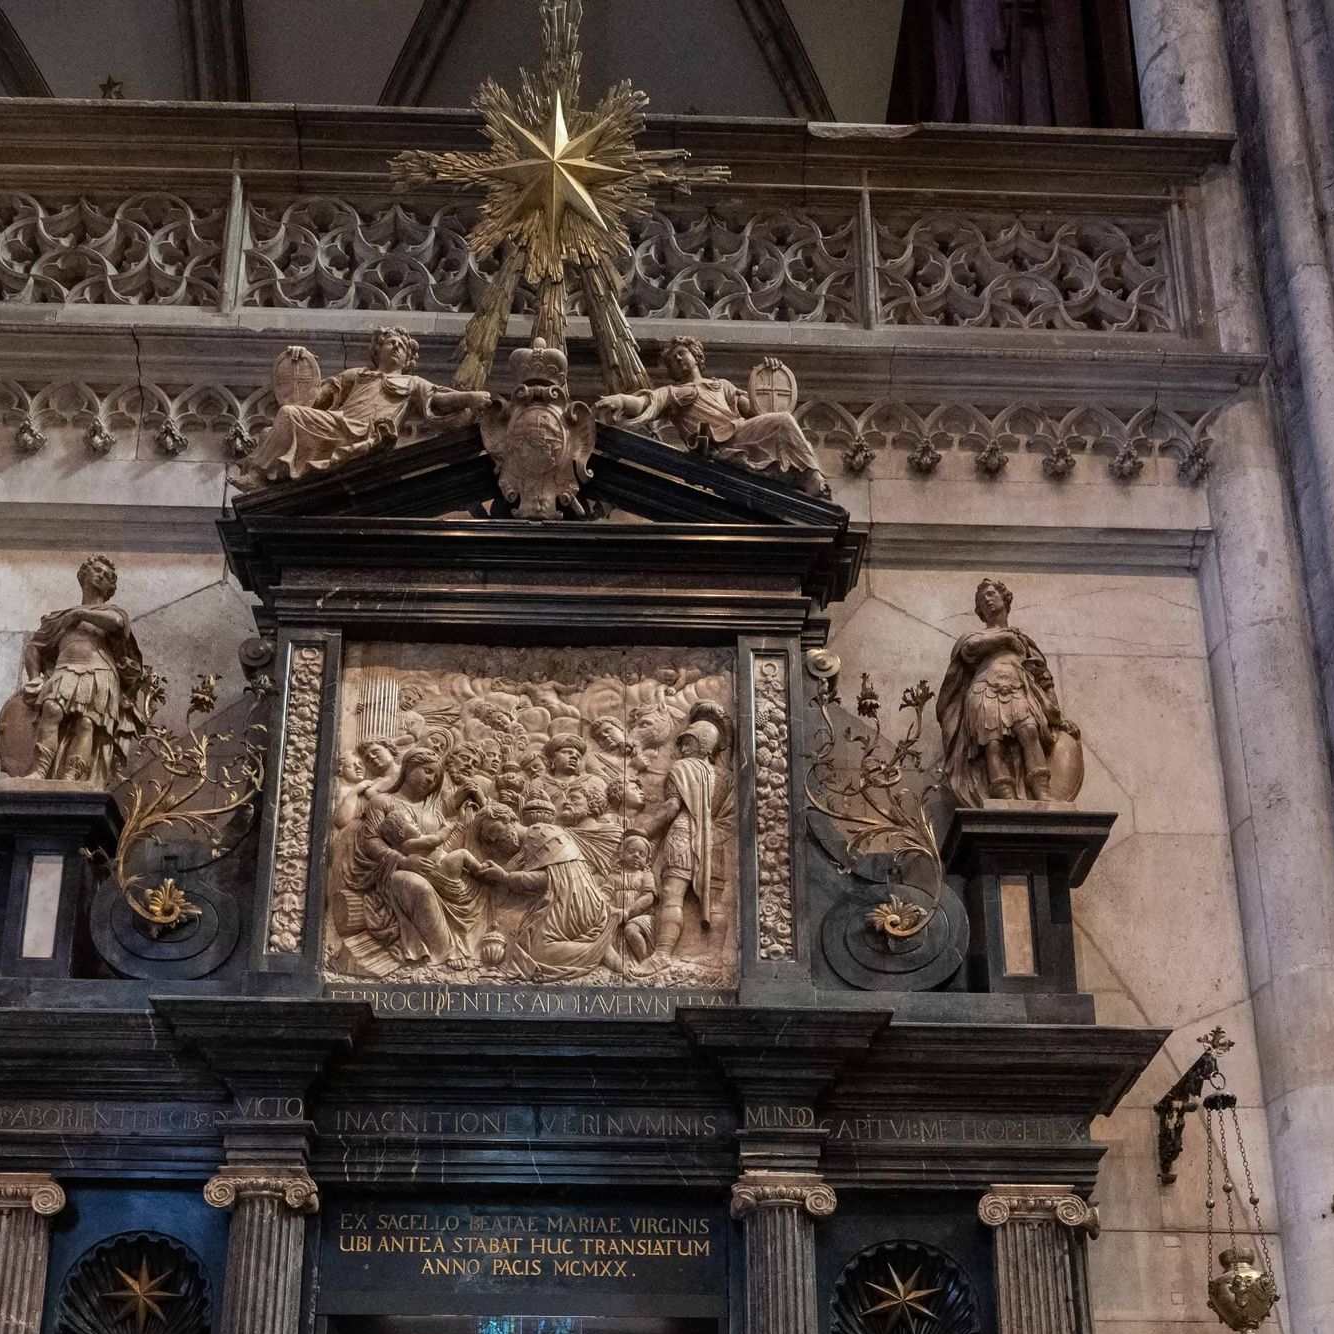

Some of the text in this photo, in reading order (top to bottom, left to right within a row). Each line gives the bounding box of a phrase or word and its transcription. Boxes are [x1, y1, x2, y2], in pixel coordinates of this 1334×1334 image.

[341, 1214, 710, 1234] EX SACELLO BEATAE MARIAE VIRGINIS
[339, 1235, 711, 1257] UBI ANTEA STABAT HUC TRANSLATUM
[421, 1259, 480, 1275] ANNO
[492, 1259, 542, 1276] PACIS
